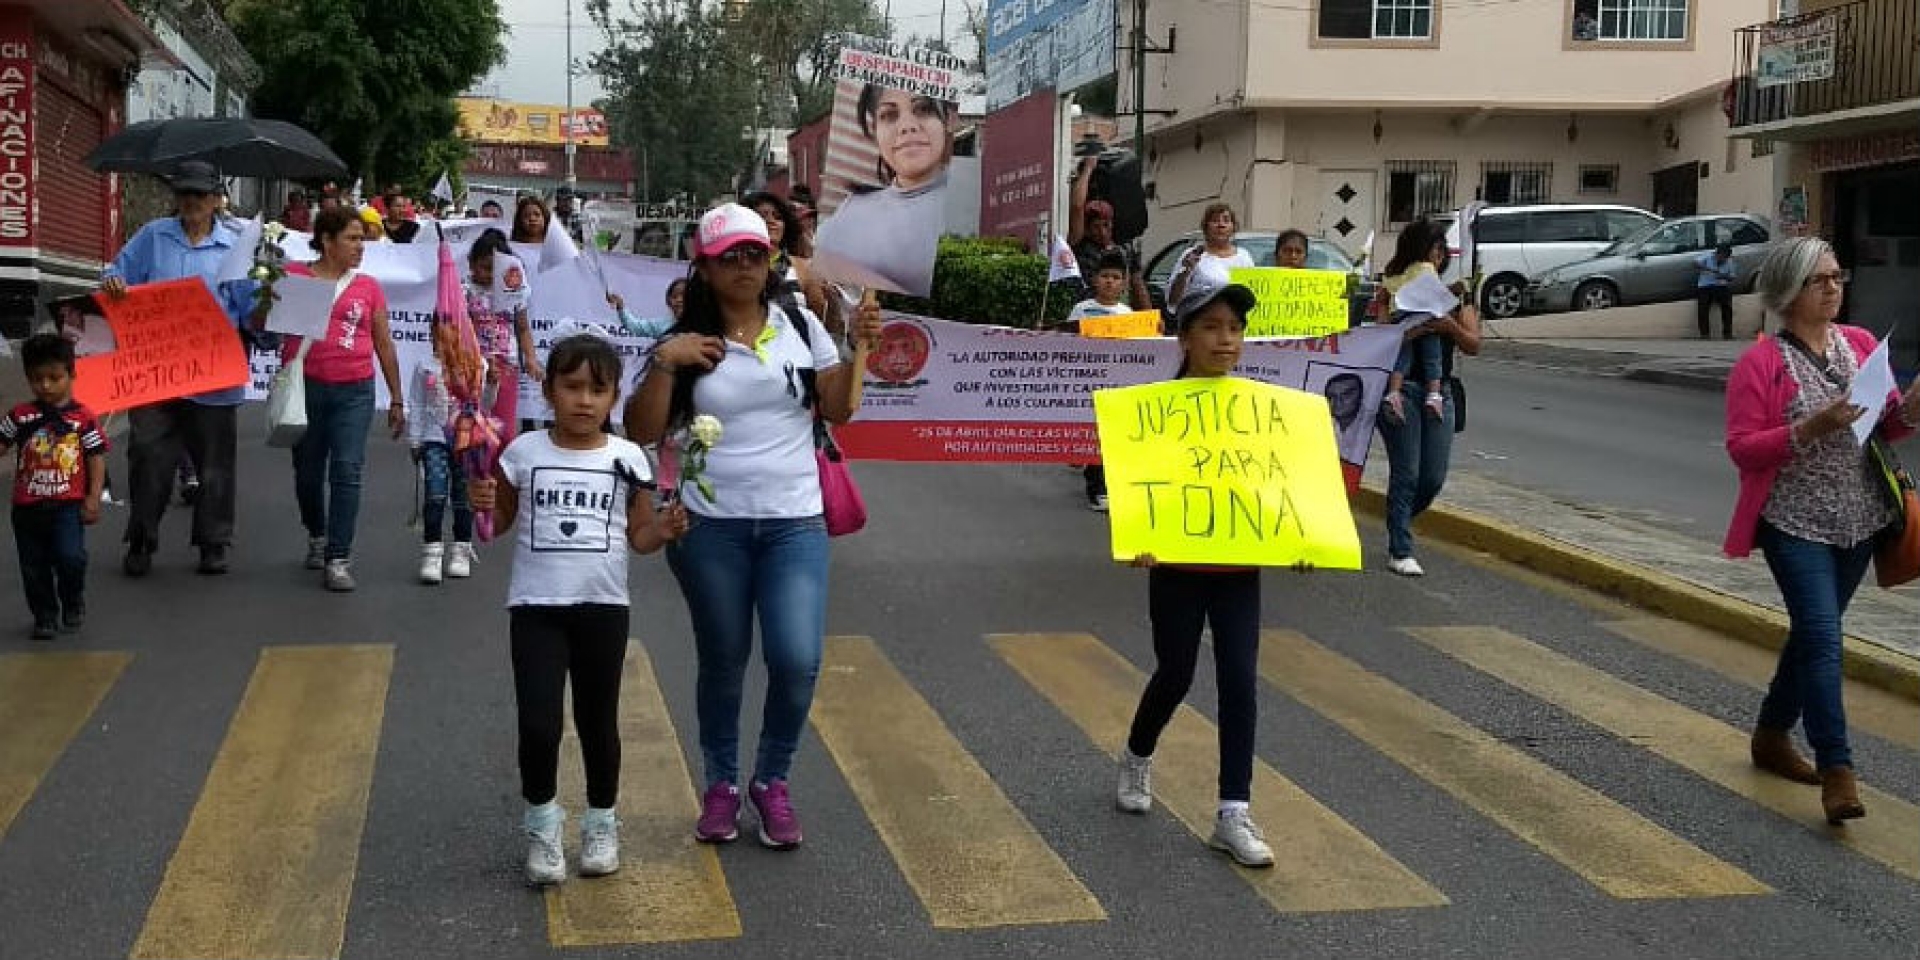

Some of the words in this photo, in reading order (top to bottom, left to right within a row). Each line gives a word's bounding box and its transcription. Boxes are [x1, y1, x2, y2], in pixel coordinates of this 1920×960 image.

[2, 43, 26, 59] CH
[0, 67, 27, 238] AFINACIONES
[973, 351, 1048, 364] AUTORIDAD
[1052, 352, 1109, 364] PREFIERE
[989, 367, 1016, 378] CON
[1019, 367, 1044, 378] LAS
[954, 381, 980, 393] QUE
[983, 382, 1059, 394] INVESTIGAR
[998, 397, 1019, 408] LOS
[1128, 390, 1289, 442] JUSTICIA
[1188, 446, 1287, 481] PARA
[535, 490, 611, 510] CHERIE
[1128, 481, 1304, 541] TONA
